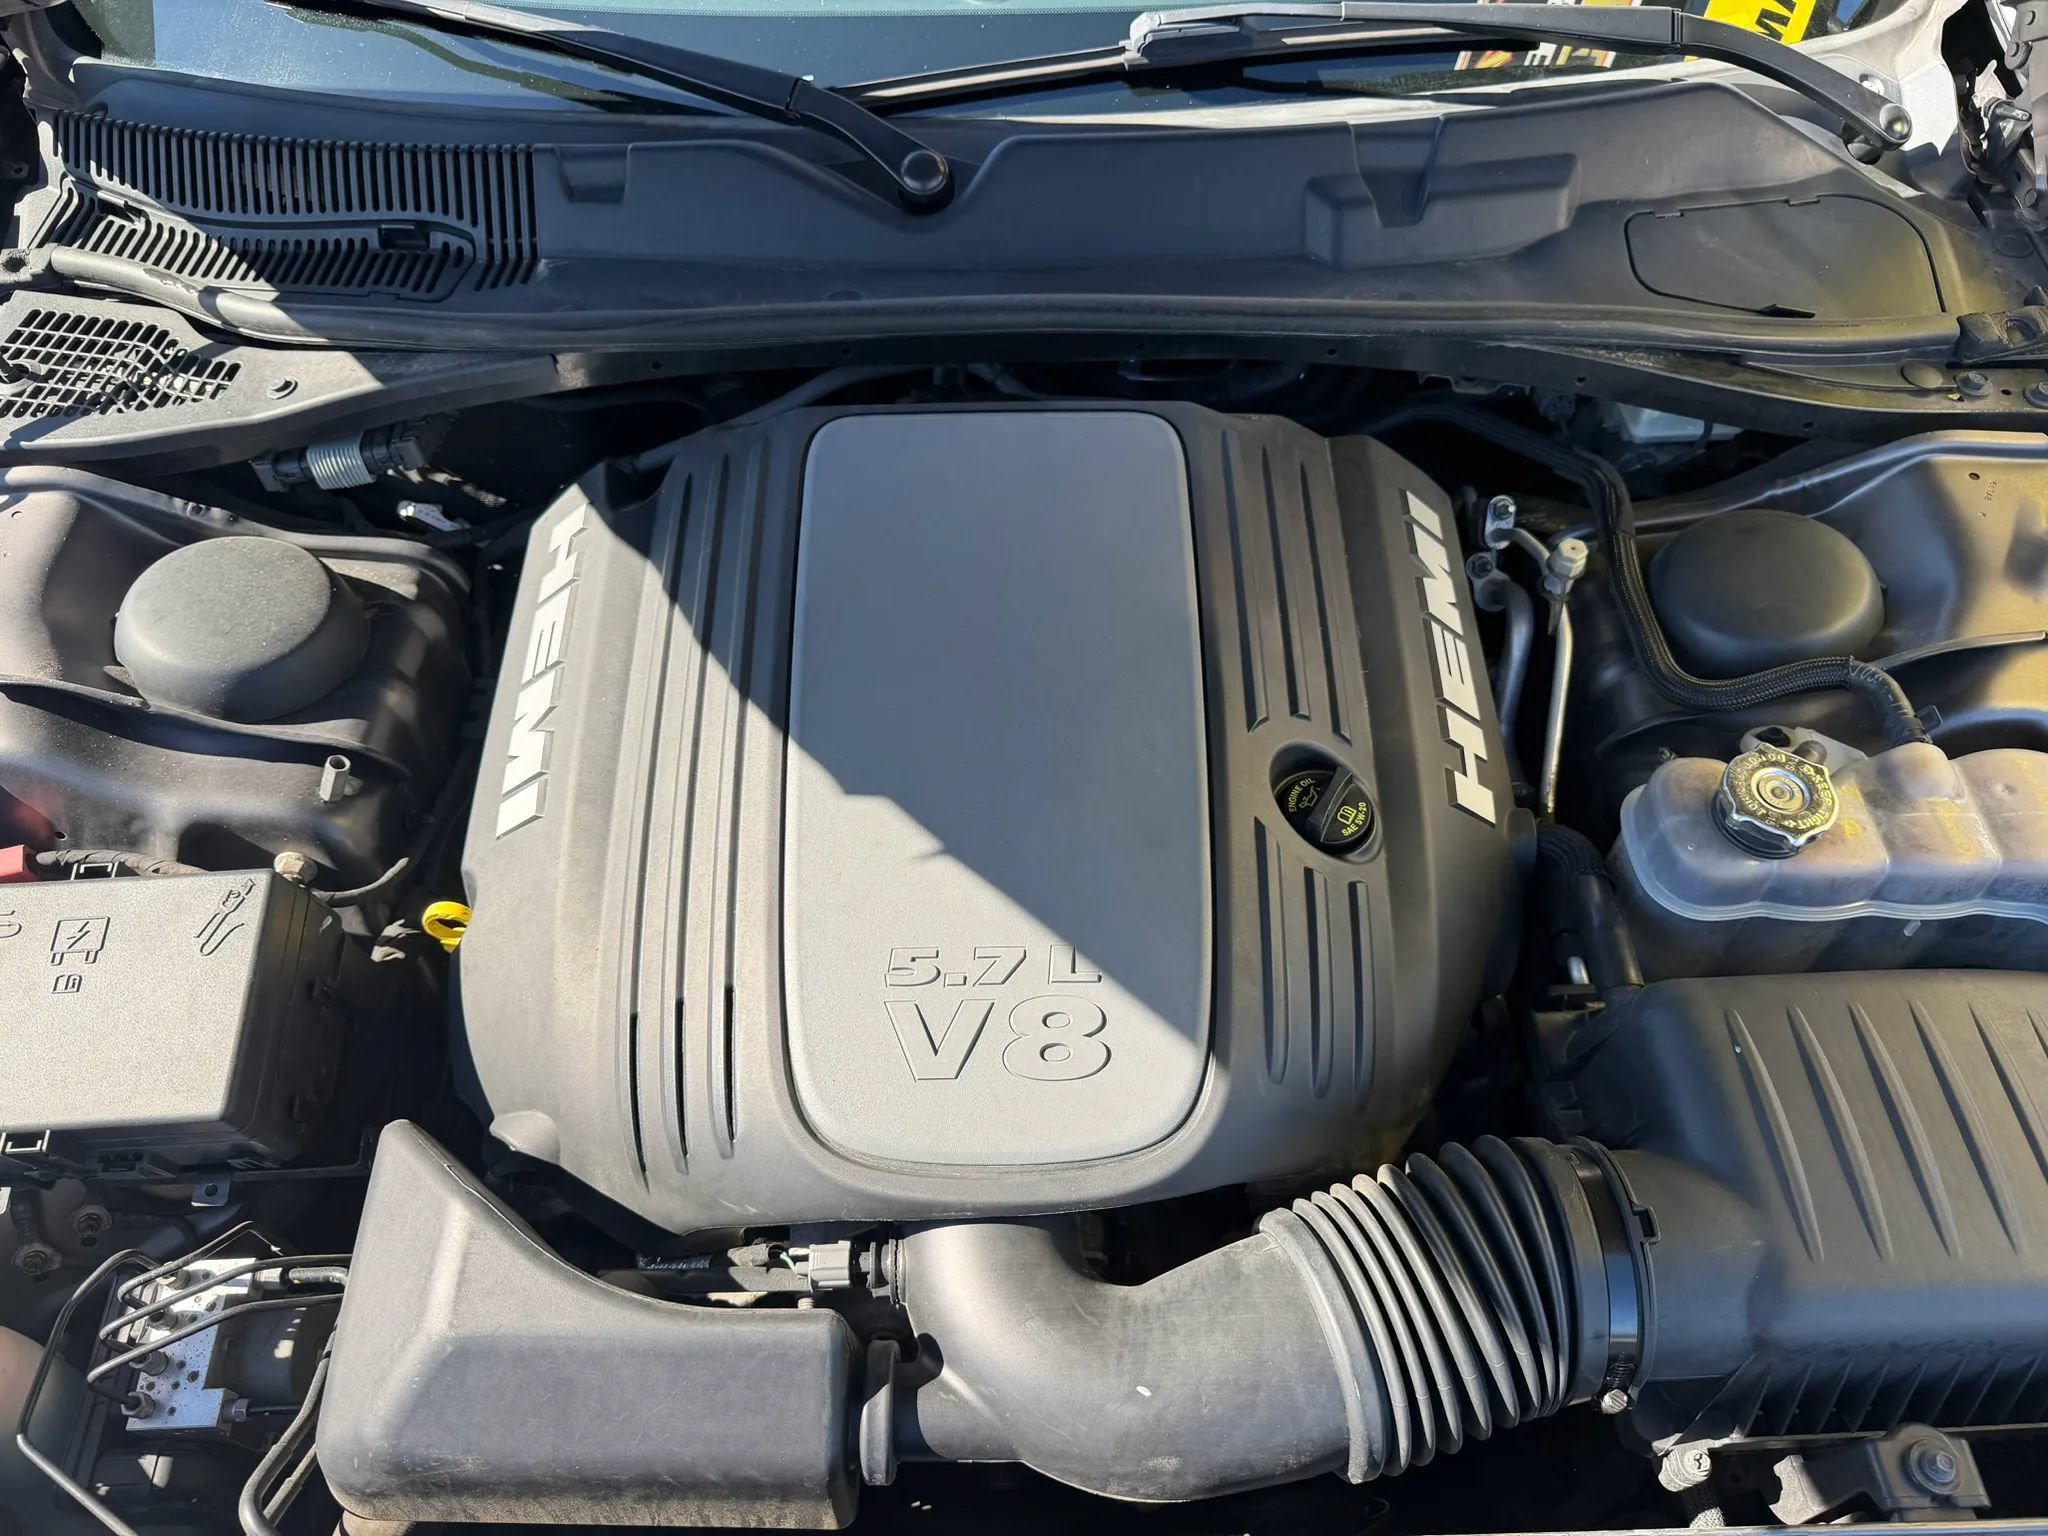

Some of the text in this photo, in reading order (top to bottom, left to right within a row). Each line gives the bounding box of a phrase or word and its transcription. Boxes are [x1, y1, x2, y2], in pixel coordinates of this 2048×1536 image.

[496, 502, 588, 839] HEMI
[1402, 488, 1496, 827] HEMI
[1288, 778, 1316, 812] ENGINE OIL
[1341, 802, 1367, 836] SAE 5W-20
[884, 995, 1112, 1083] V8
